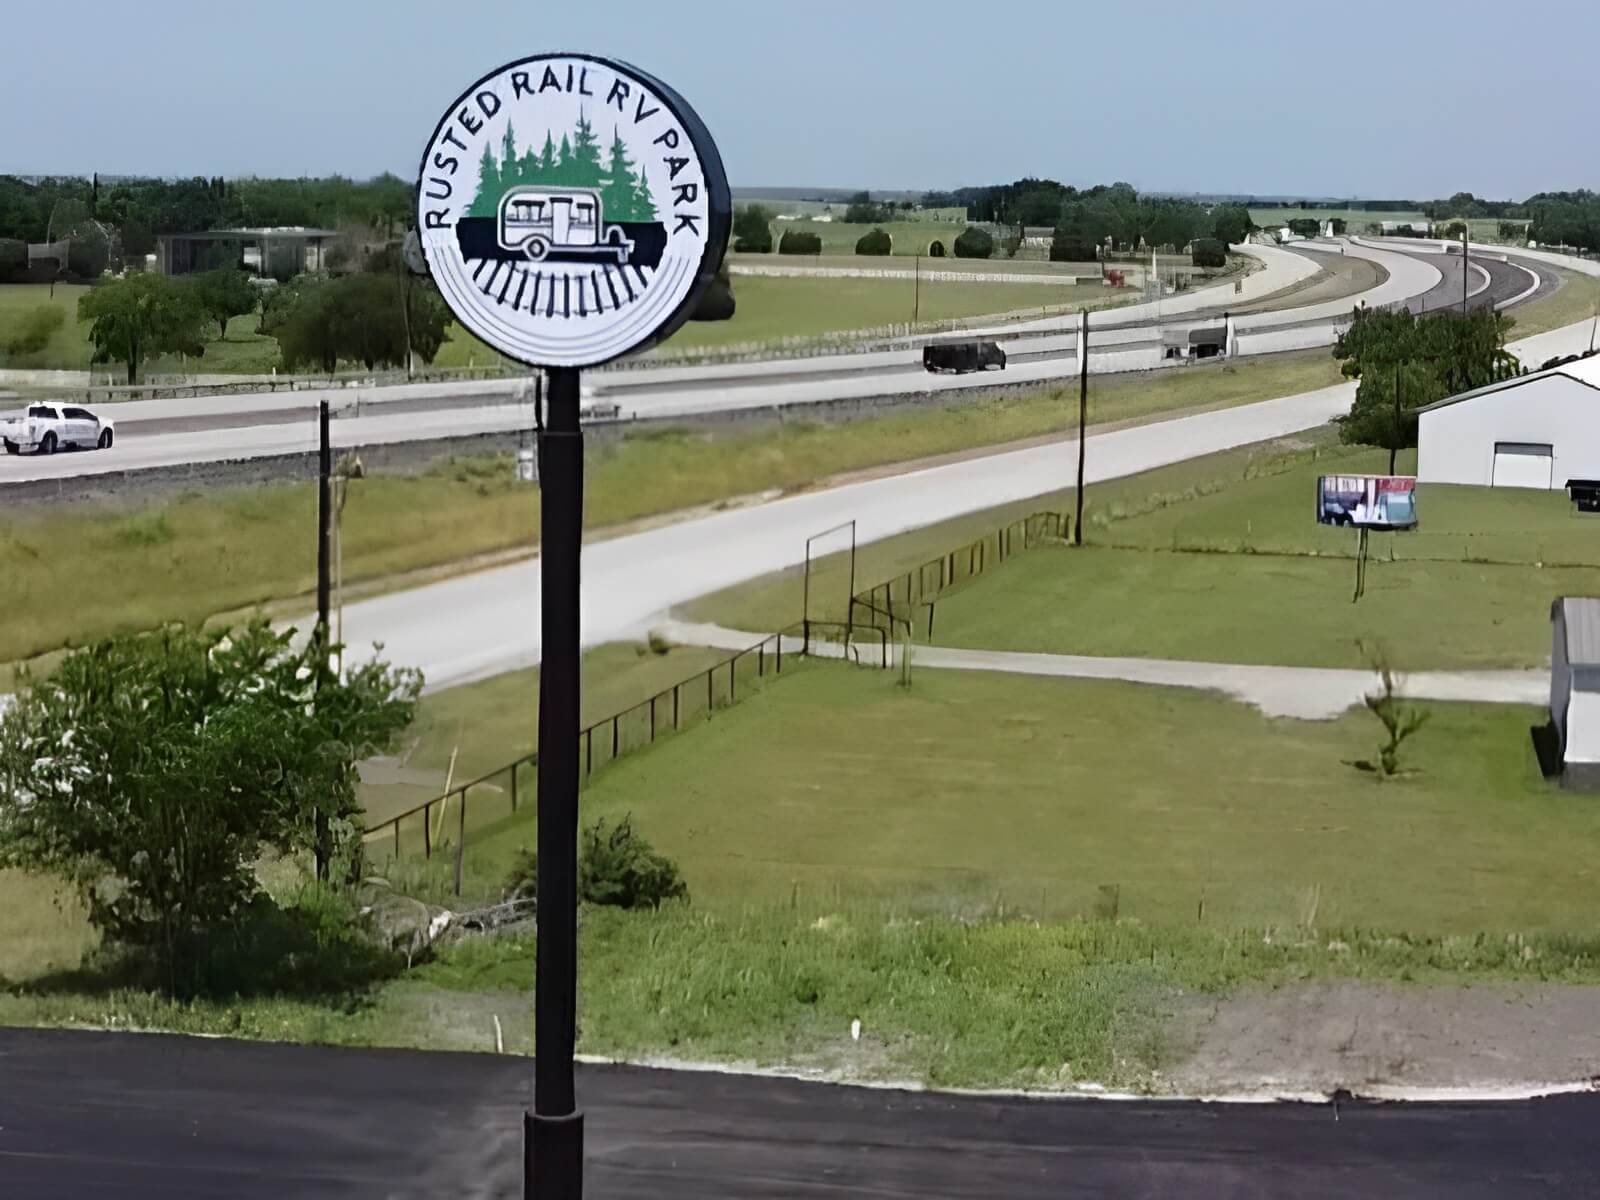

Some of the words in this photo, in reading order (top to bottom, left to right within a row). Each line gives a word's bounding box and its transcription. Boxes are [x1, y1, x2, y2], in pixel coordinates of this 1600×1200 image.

[425, 90, 501, 229] RUSTED
[511, 64, 593, 100] RAIL
[607, 78, 660, 124] RV
[653, 128, 700, 238] PARK
